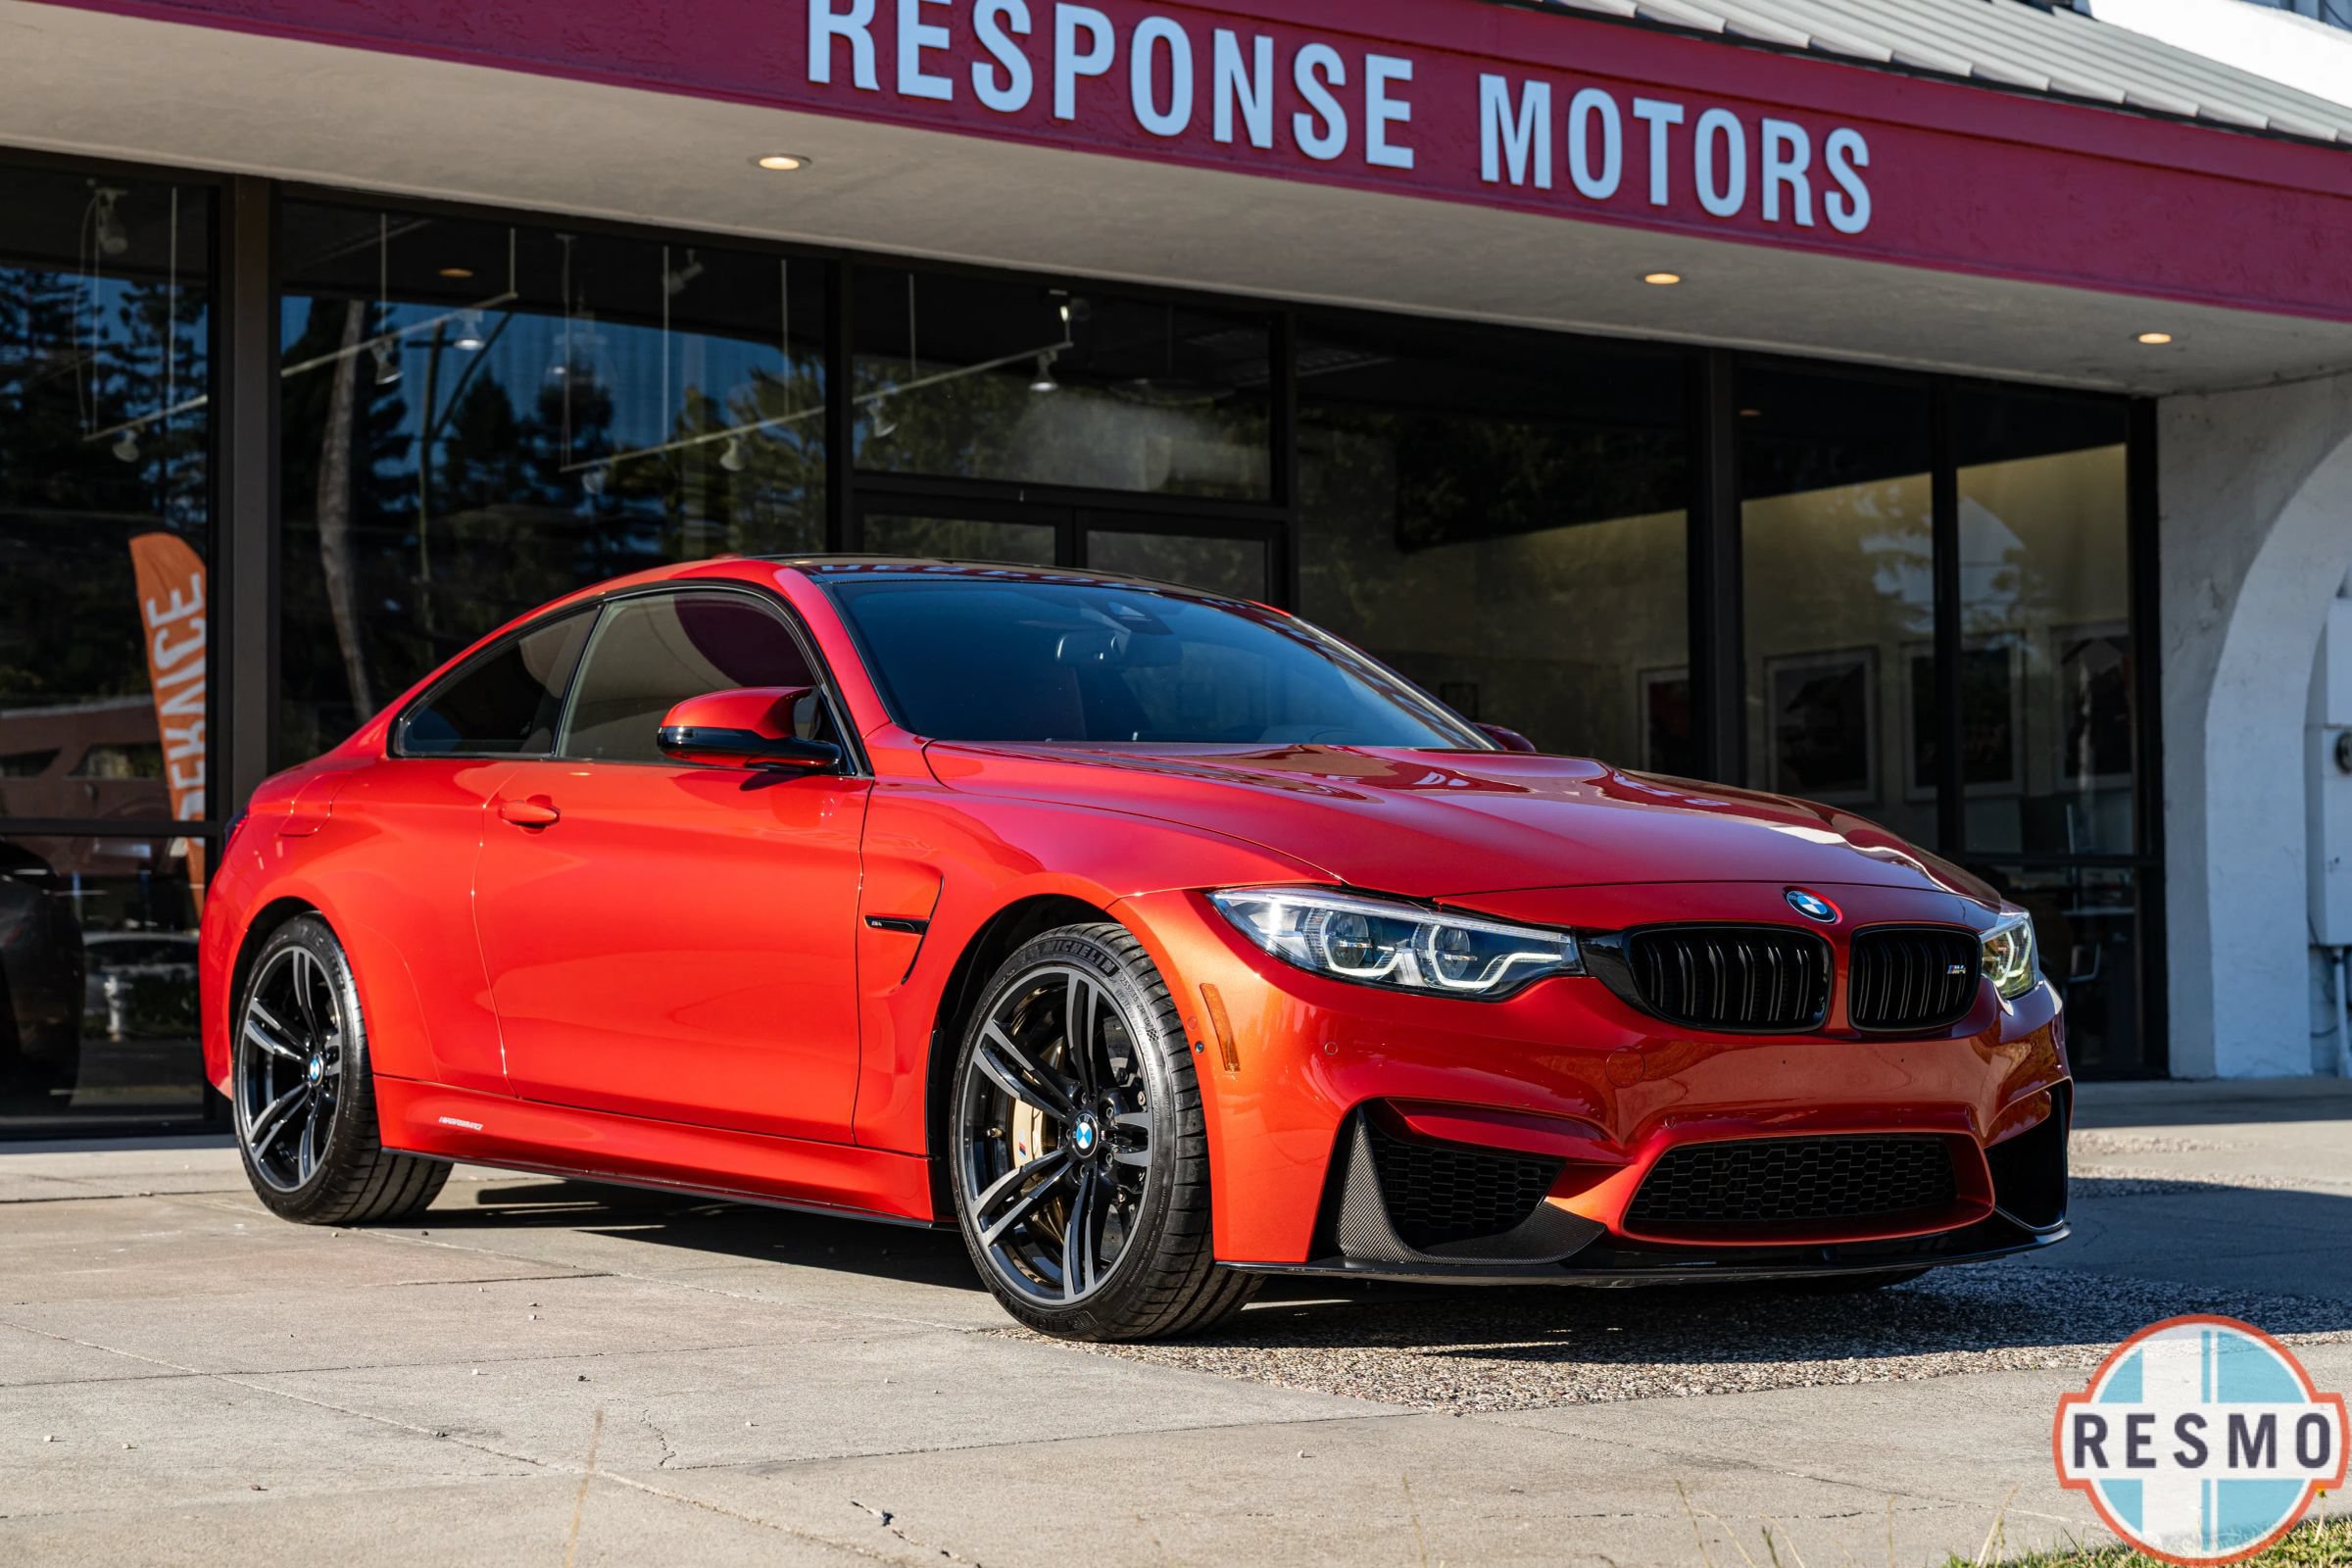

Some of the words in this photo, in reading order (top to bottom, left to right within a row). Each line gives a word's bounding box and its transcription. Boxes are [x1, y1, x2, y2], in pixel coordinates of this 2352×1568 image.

[808, 0, 1414, 170] RESPONSE
[1479, 74, 1871, 234] MOTORS
[1043, 939, 1116, 974] MICHELIN
